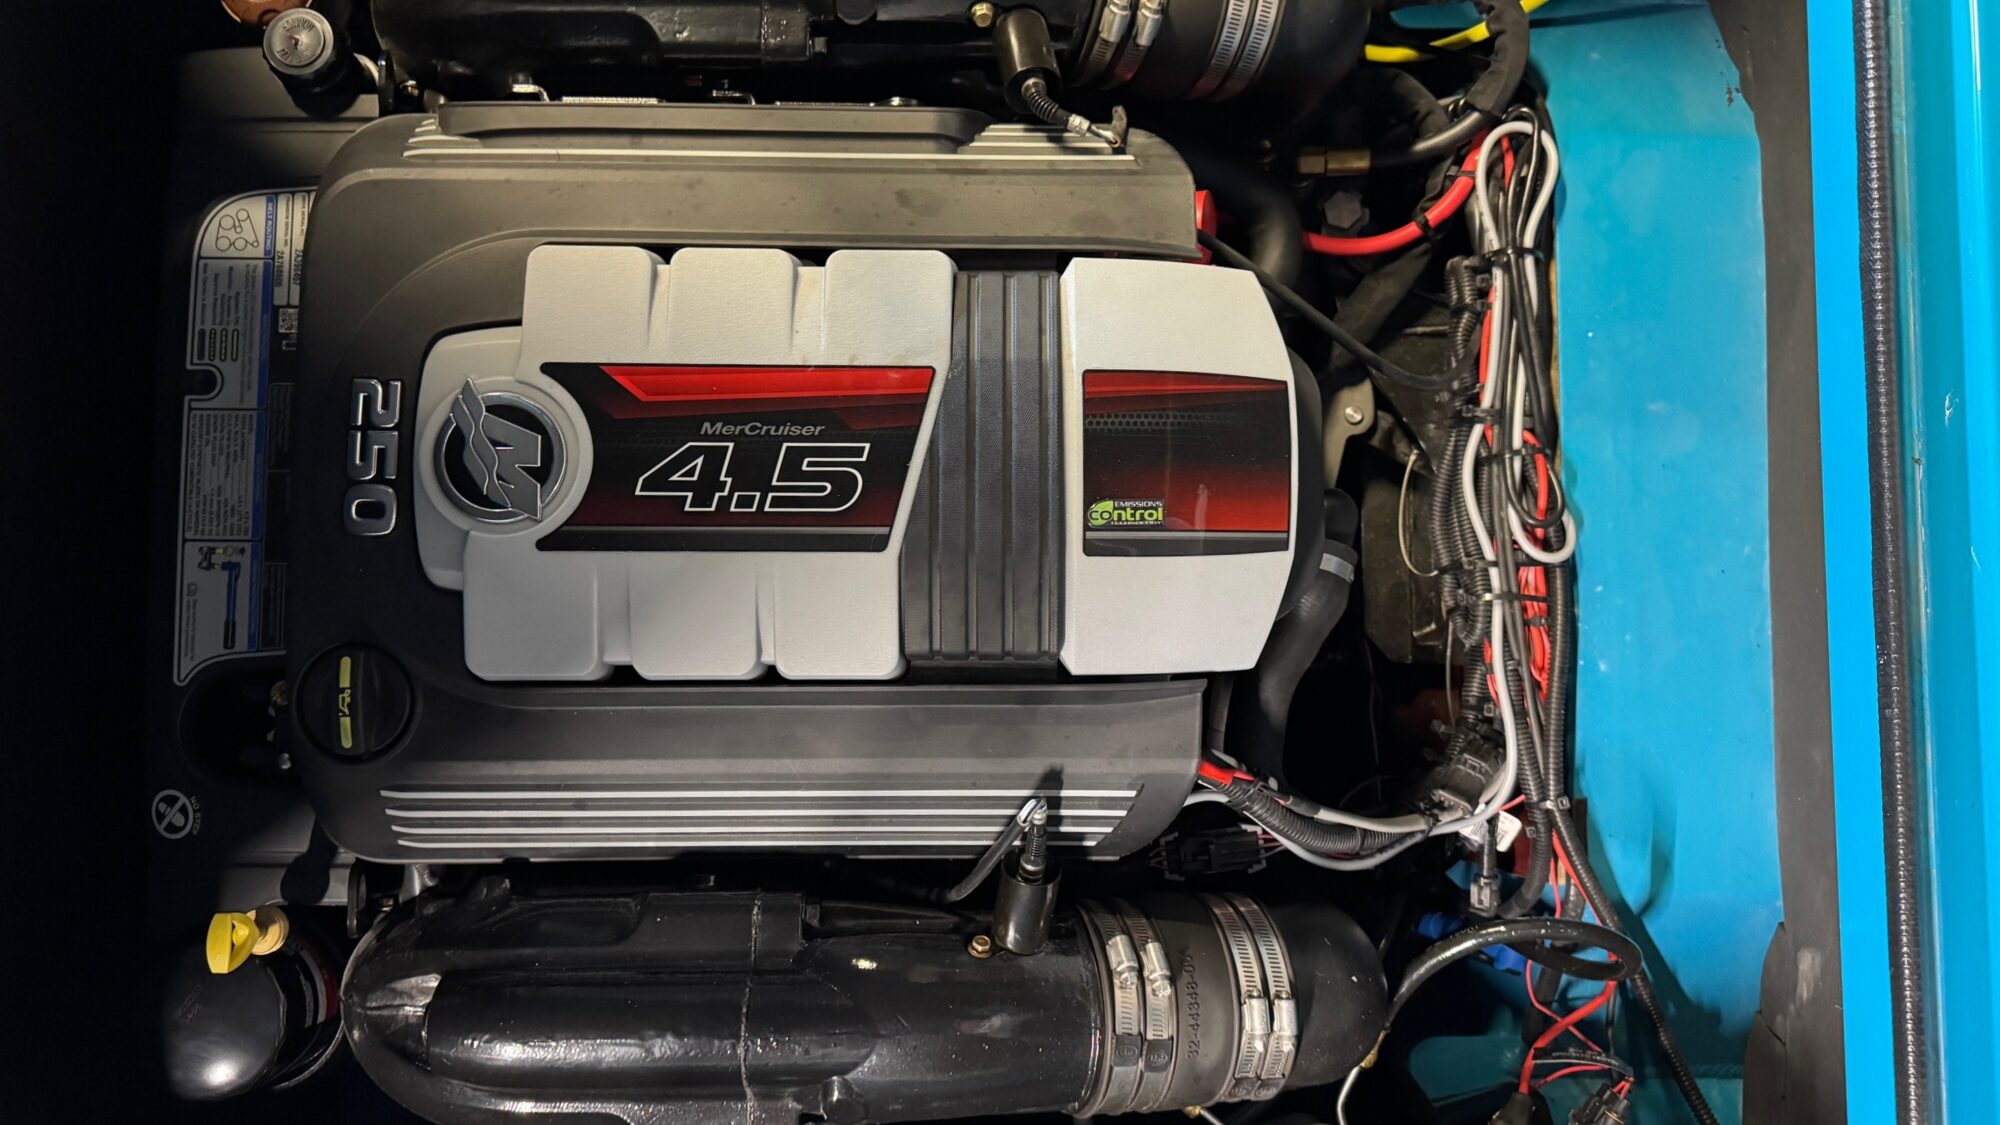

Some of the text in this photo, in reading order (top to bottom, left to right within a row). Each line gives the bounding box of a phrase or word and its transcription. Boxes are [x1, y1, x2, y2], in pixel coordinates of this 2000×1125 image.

[700, 422, 825, 436] MerCruiser
[343, 378, 401, 536] 250
[634, 442, 871, 512] 4.5
[1089, 507, 1163, 521] control
